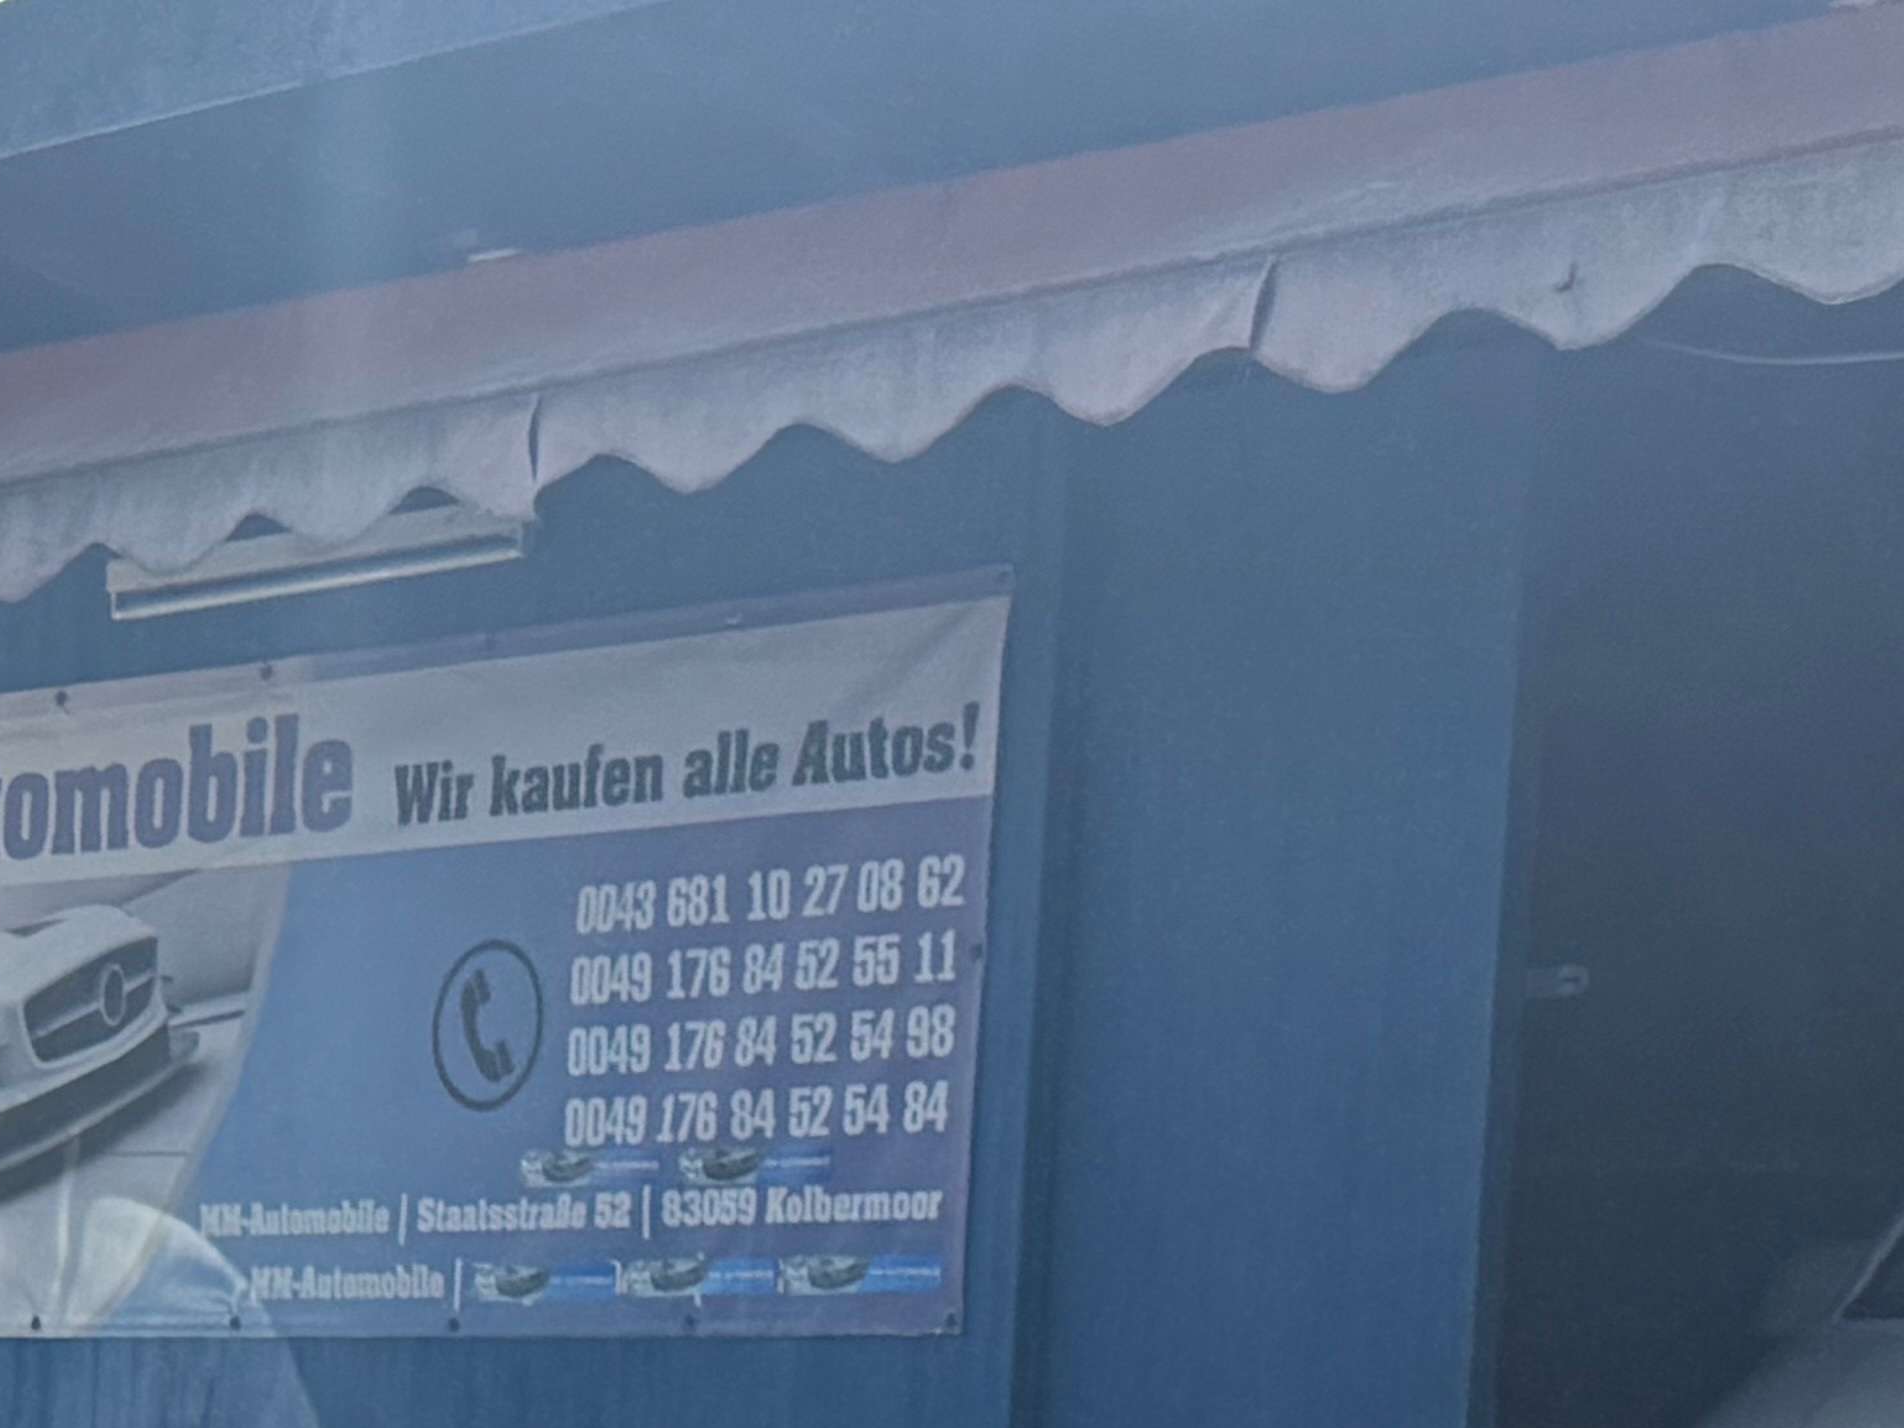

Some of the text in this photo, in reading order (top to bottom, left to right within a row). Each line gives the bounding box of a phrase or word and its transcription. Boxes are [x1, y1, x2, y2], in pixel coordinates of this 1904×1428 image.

[395, 760, 474, 826] Wir
[489, 743, 663, 816] kaufen
[683, 728, 780, 799] alle
[792, 701, 980, 786] Autos!
[576, 853, 965, 934] 0043 681 10 27 08 62
[570, 928, 956, 1005] 0049 176 84 52 55 11
[568, 1003, 955, 1076] 0049 176 84 52 54 98
[565, 1080, 949, 1147] 0049 176 84 52 54 84
[200, 1199, 390, 1236] MM-Automobile
[417, 1193, 587, 1232] Staatsstraße
[594, 1192, 631, 1229] 52
[662, 1188, 757, 1227] 83059
[765, 1184, 943, 1224] Kolbermoor
[249, 1264, 445, 1300] MM-Automobile
